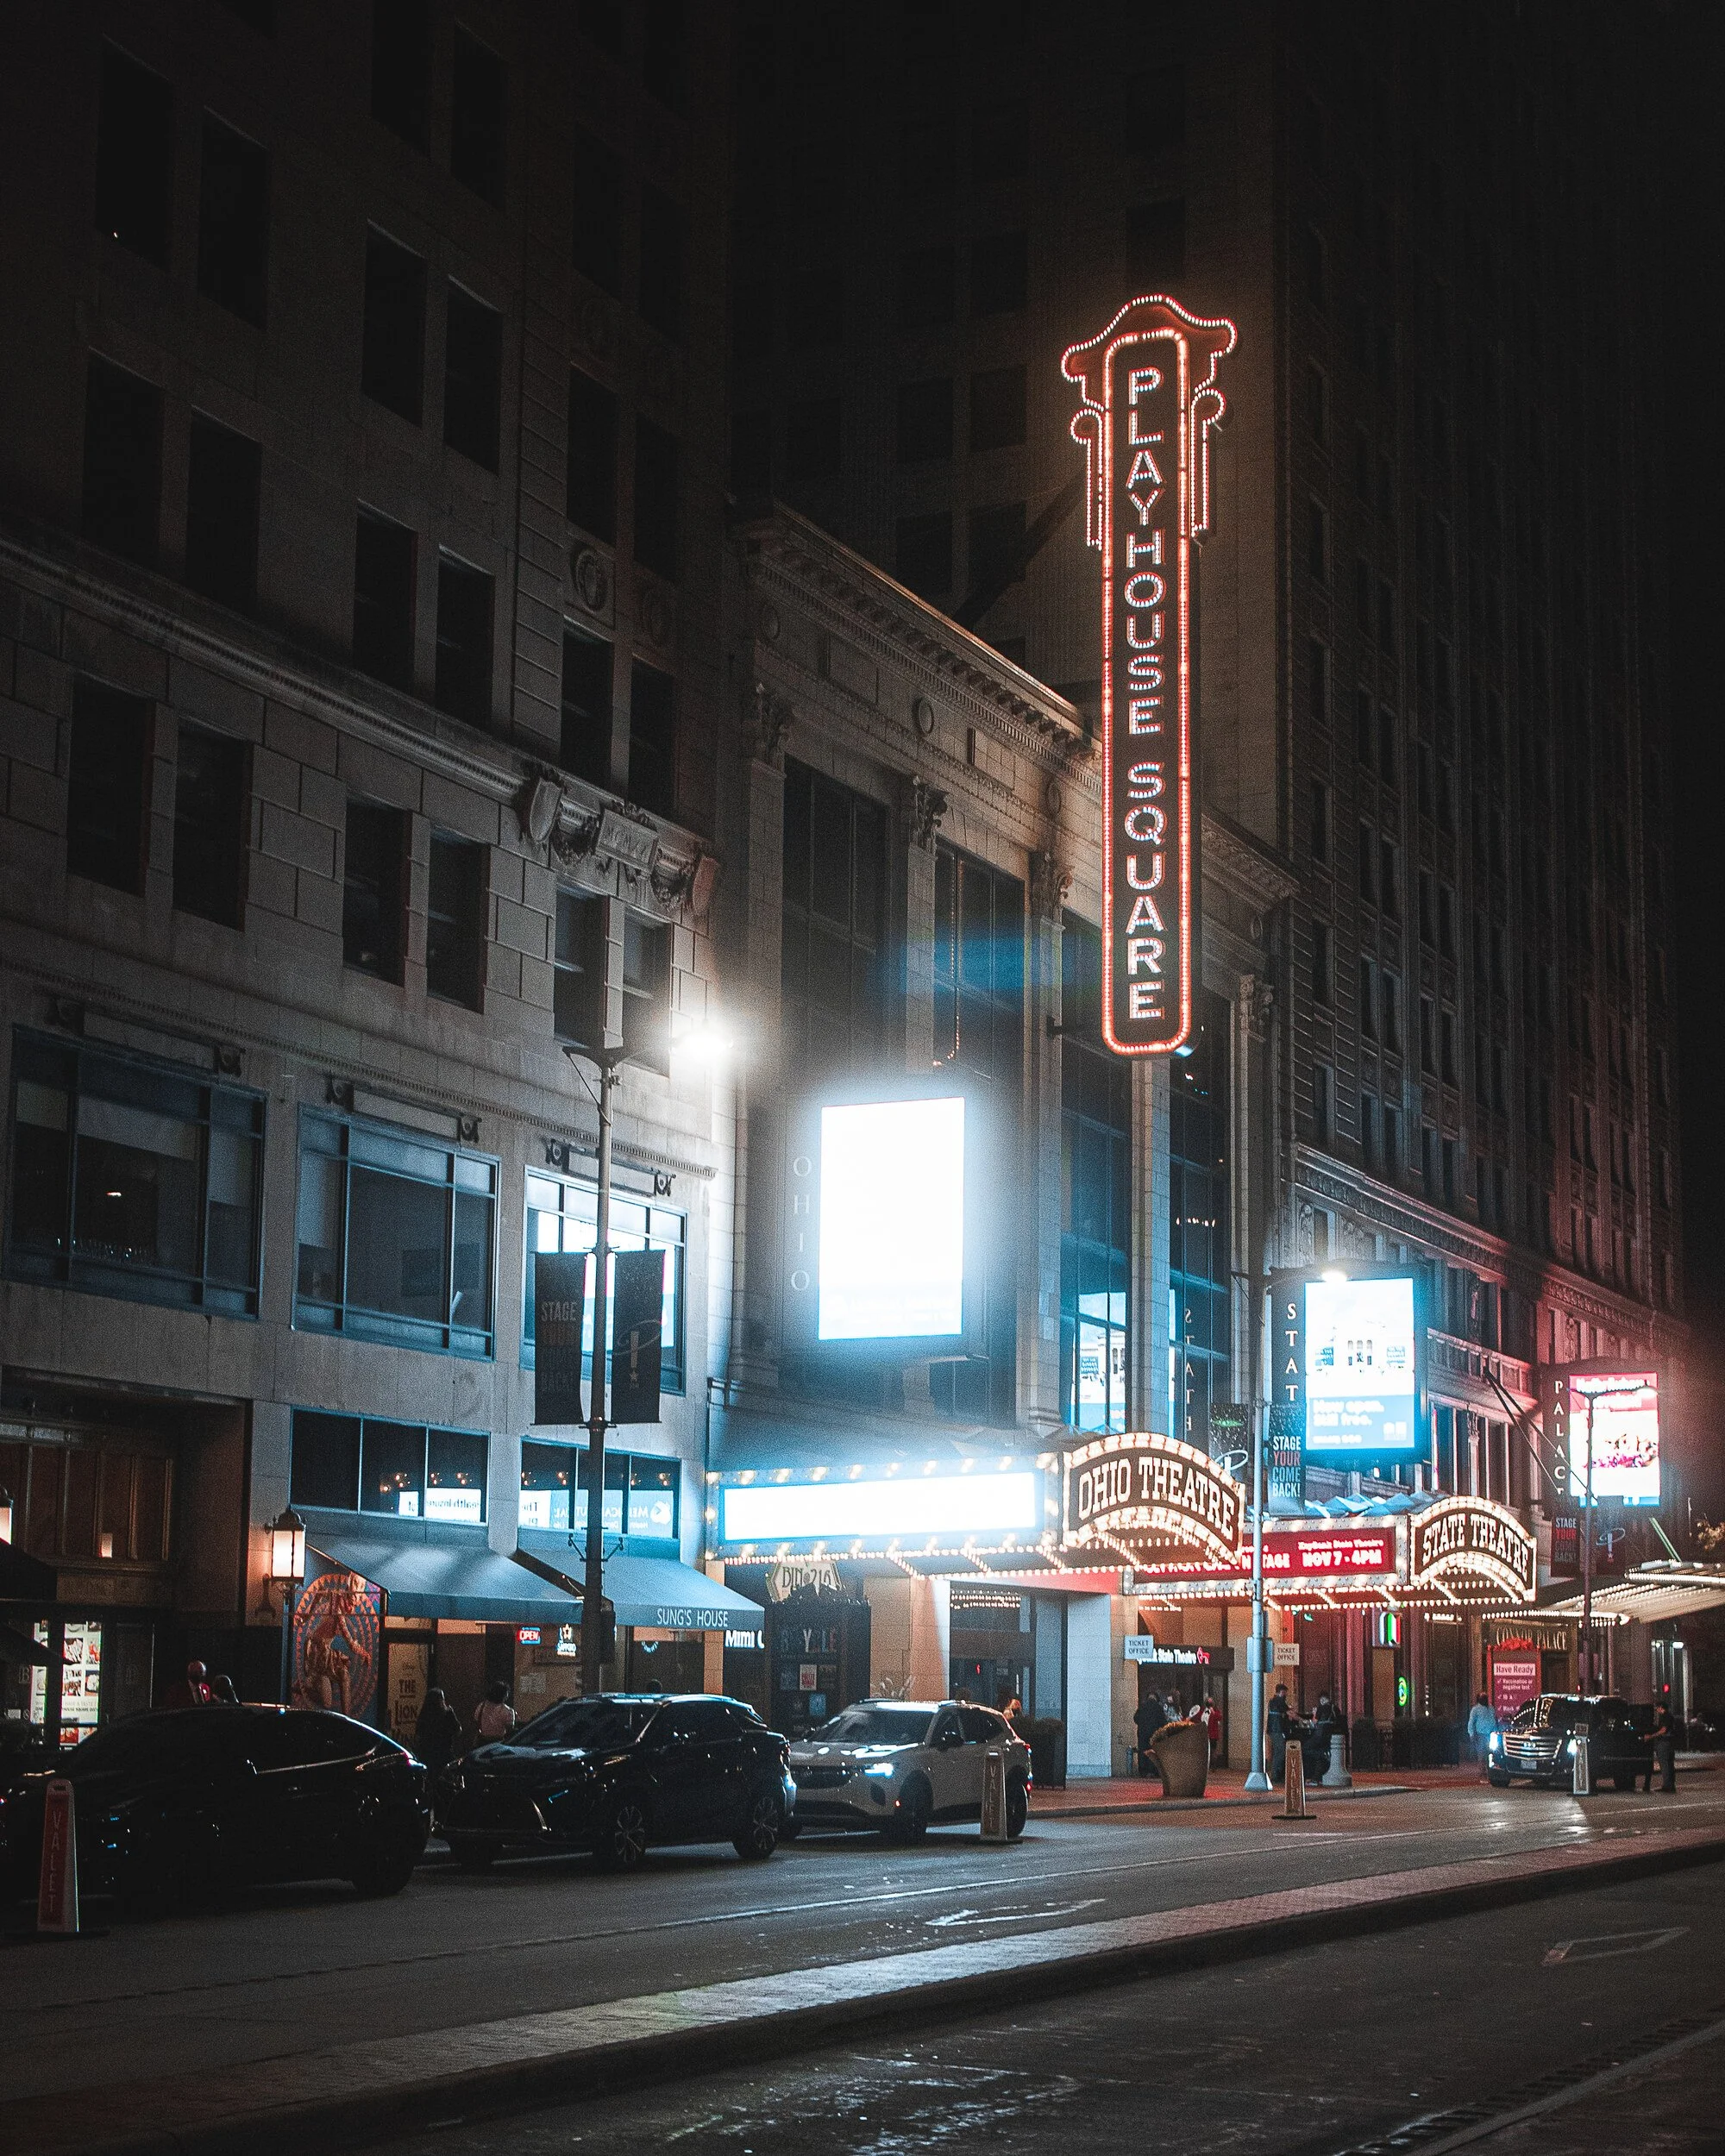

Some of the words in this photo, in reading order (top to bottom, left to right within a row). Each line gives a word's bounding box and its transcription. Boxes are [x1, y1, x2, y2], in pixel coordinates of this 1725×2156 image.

[1124, 367, 1166, 737] PLAYHOUSE
[1124, 761, 1166, 1021] SQUARE
[790, 1156, 812, 1292] OHIO
[541, 1300, 577, 1321] STAGE
[1272, 1436, 1302, 1451] STAGE
[1273, 1451, 1301, 1466] YOUR
[1272, 1466, 1301, 1482] COME
[1272, 1482, 1301, 1497] BACK!
[1078, 1457, 1132, 1521] OHIO
[1138, 1456, 1235, 1541] THEATRE
[1555, 1517, 1577, 1528] STAGE
[1555, 1528, 1577, 1540] YOUR
[1422, 1513, 1466, 1567] STATE
[1470, 1513, 1528, 1583] THEATRE
[1262, 1553, 1290, 1570] TAGE
[1302, 1551, 1333, 1567] NOV
[1333, 1551, 1342, 1566] 7
[1351, 1549, 1383, 1565] 4PM
[1555, 1551, 1577, 1564] BACK!
[782, 1566, 804, 1589] BIN
[810, 1569, 832, 1587] 216
[657, 1608, 692, 1626] SUNG'S
[697, 1610, 729, 1627] HOUSE
[519, 1630, 539, 1640] OPEN
[1536, 1628, 1567, 1650] PALACE
[1157, 1648, 1174, 1664] State
[1173, 1649, 1197, 1664] Theatre
[1496, 1665, 1512, 1674] Have
[1513, 1665, 1534, 1677] Ready
[398, 1679, 416, 1693] THE
[49, 1810, 62, 1913] VALET
